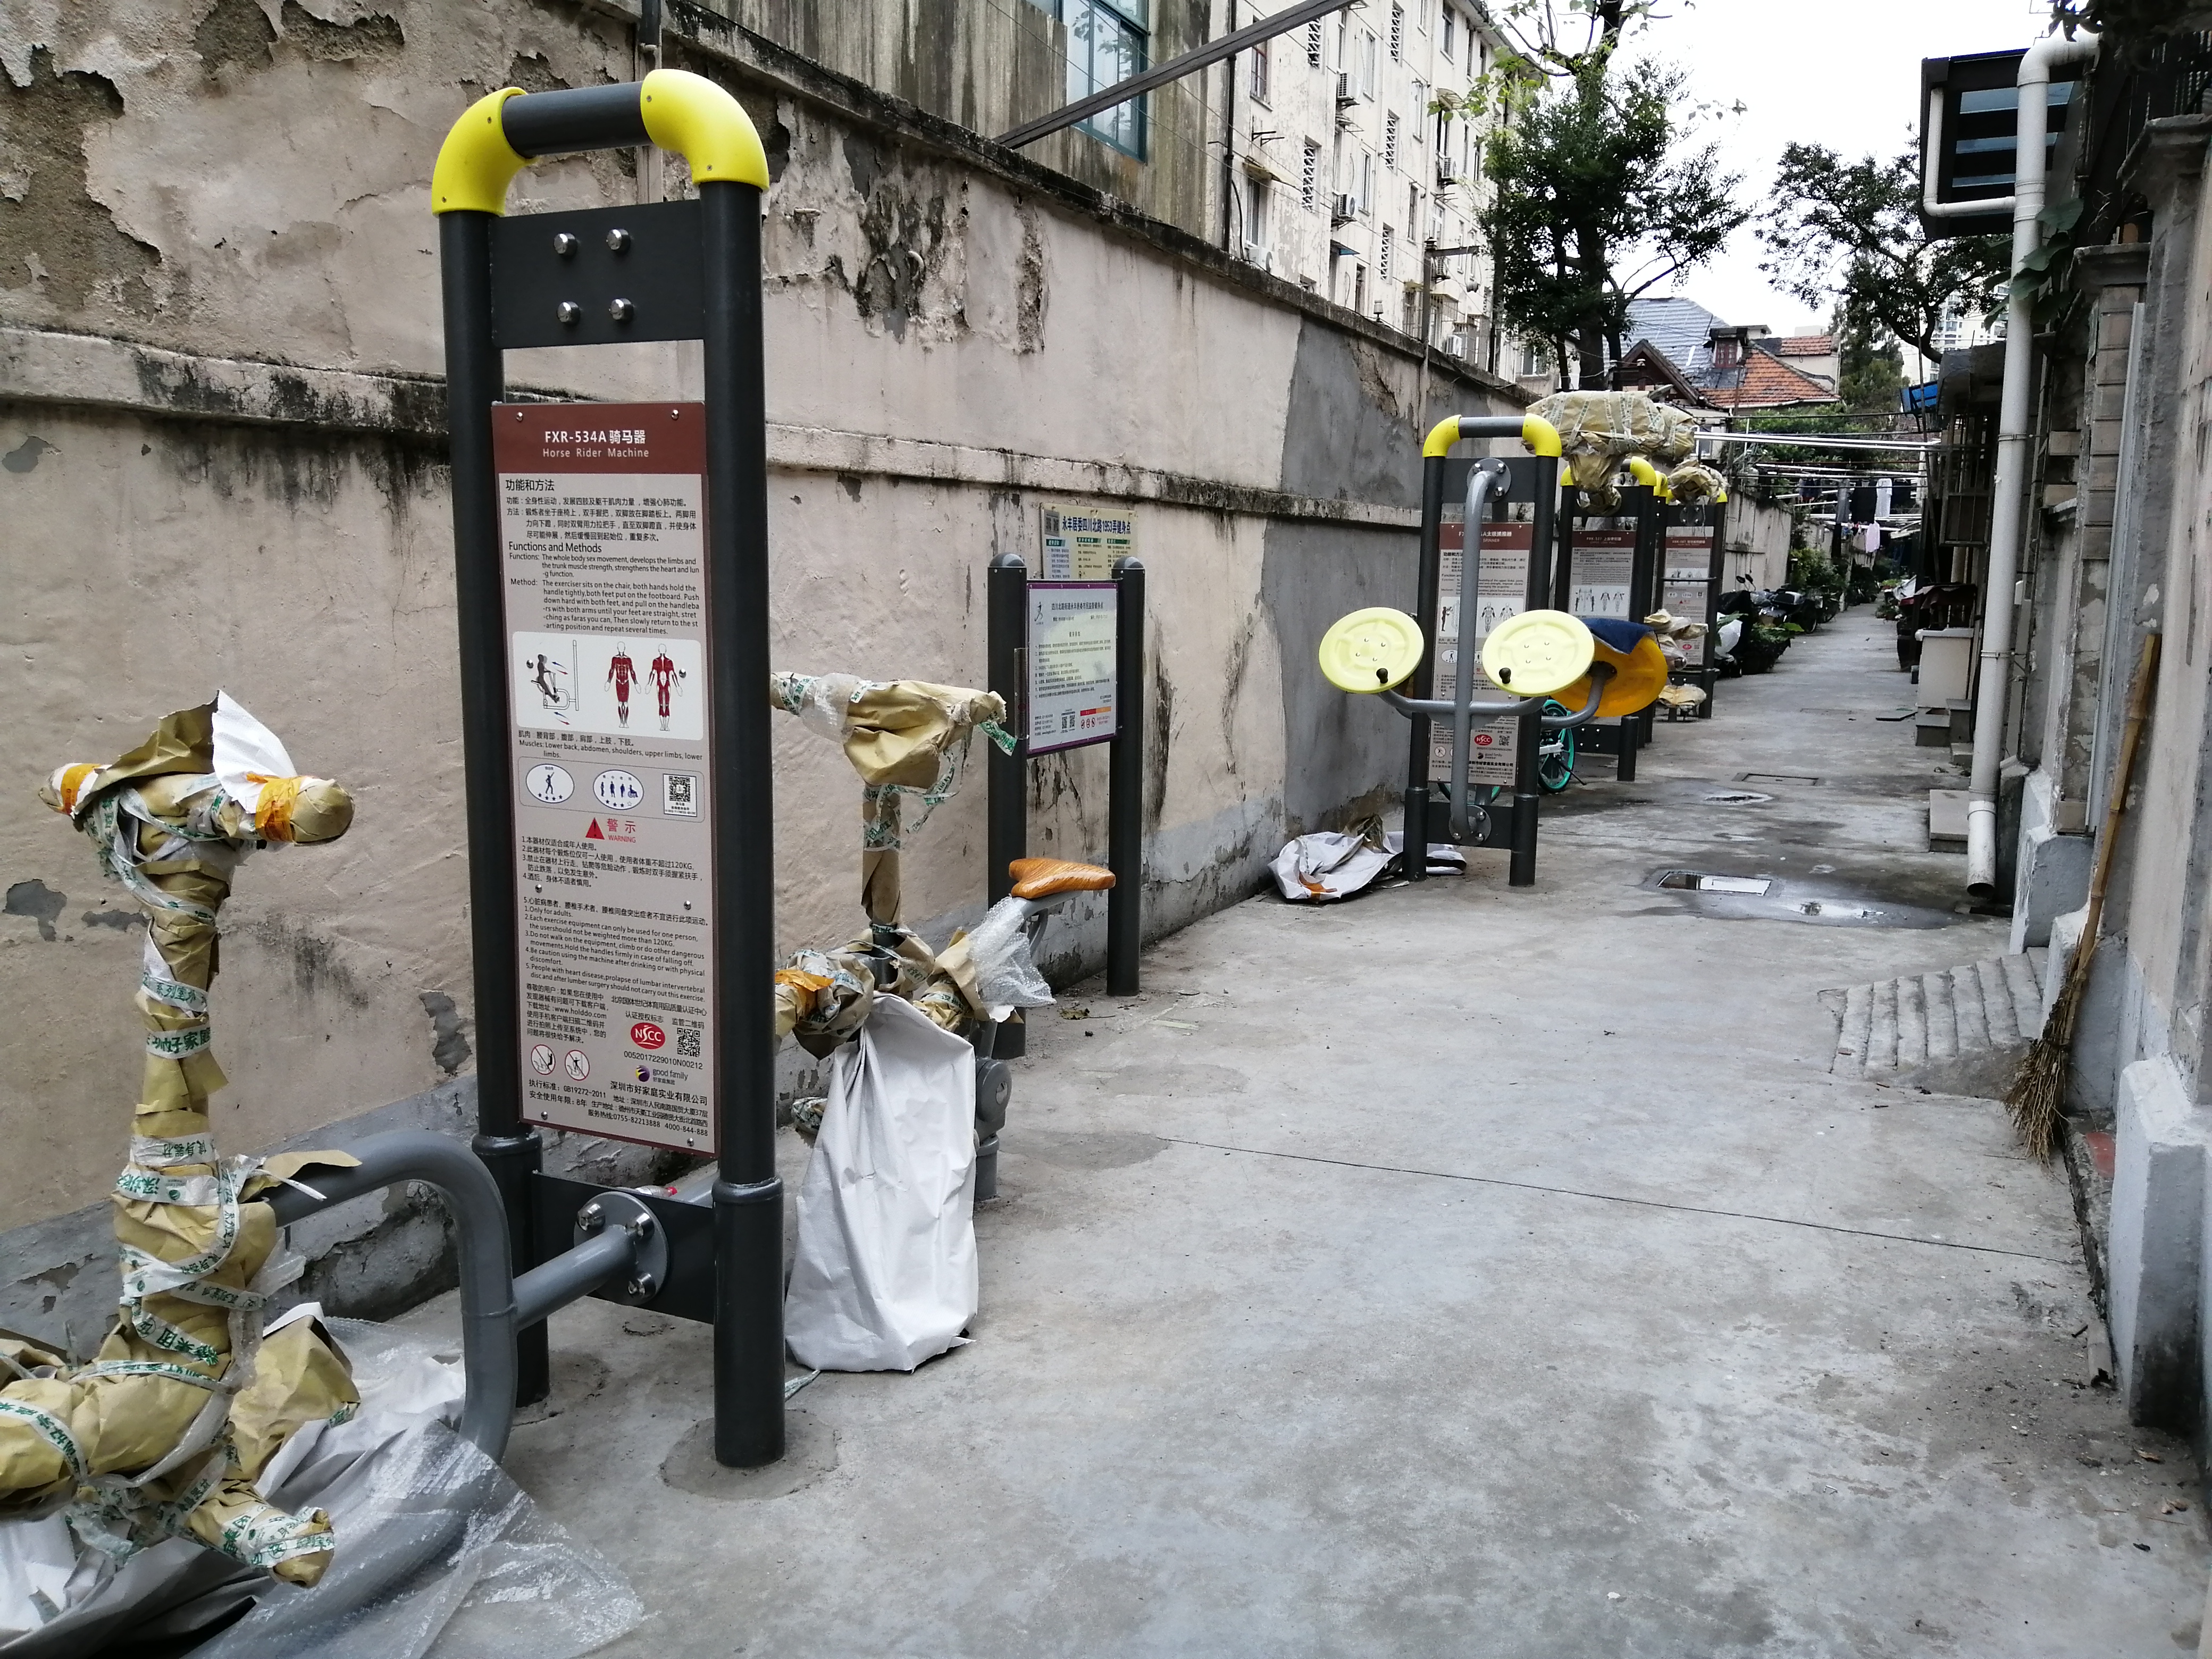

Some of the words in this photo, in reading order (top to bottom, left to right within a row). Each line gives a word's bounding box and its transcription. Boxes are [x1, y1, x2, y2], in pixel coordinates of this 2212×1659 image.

[545, 431, 607, 443] FXR-534A
[609, 430, 646, 445] 骑马器
[543, 448, 571, 458] Horse
[576, 448, 601, 458] Rider
[608, 448, 649, 458] Machine
[506, 479, 554, 491] 功能和方法
[509, 541, 547, 551] Functions
[565, 542, 601, 551] Methods
[571, 554, 585, 563] body
[630, 556, 656, 565] develops
[653, 610, 680, 618] straight,
[630, 617, 649, 626] slowly
[581, 744, 610, 753] abdomen,
[612, 747, 643, 756] shoulders,
[665, 751, 683, 759] limbs,
[607, 818, 636, 834] 警示
[608, 834, 636, 843] WARNING
[568, 920, 600, 929] equipment
[584, 939, 617, 949] equipment,
[672, 949, 704, 959] dangerous
[530, 956, 563, 965] discomfort.
[591, 946, 614, 956] handles
[615, 950, 632, 960] firmly
[663, 956, 682, 966] falling
[631, 960, 656, 971] drinking
[531, 963, 550, 972] People
[640, 978, 661, 987] lumbar
[663, 982, 705, 993] intervertebral
[567, 976, 587, 985] lumber
[588, 981, 609, 990] surgery
[610, 983, 630, 991] should
[526, 1010, 604, 1028] 使用手机客户端扫描二维码并
[625, 1011, 663, 1023] 认证授权标志
[672, 1017, 704, 1029] 监管二维码
[634, 1024, 662, 1043] NSCC
[624, 1051, 702, 1069] 0052017229010N00212
[652, 1068, 668, 1077] good
[669, 1070, 688, 1080] family
[610, 1080, 707, 1105] 深圳市好家庭实业有限公司
[665, 1122, 707, 1136] 4000-844-888
